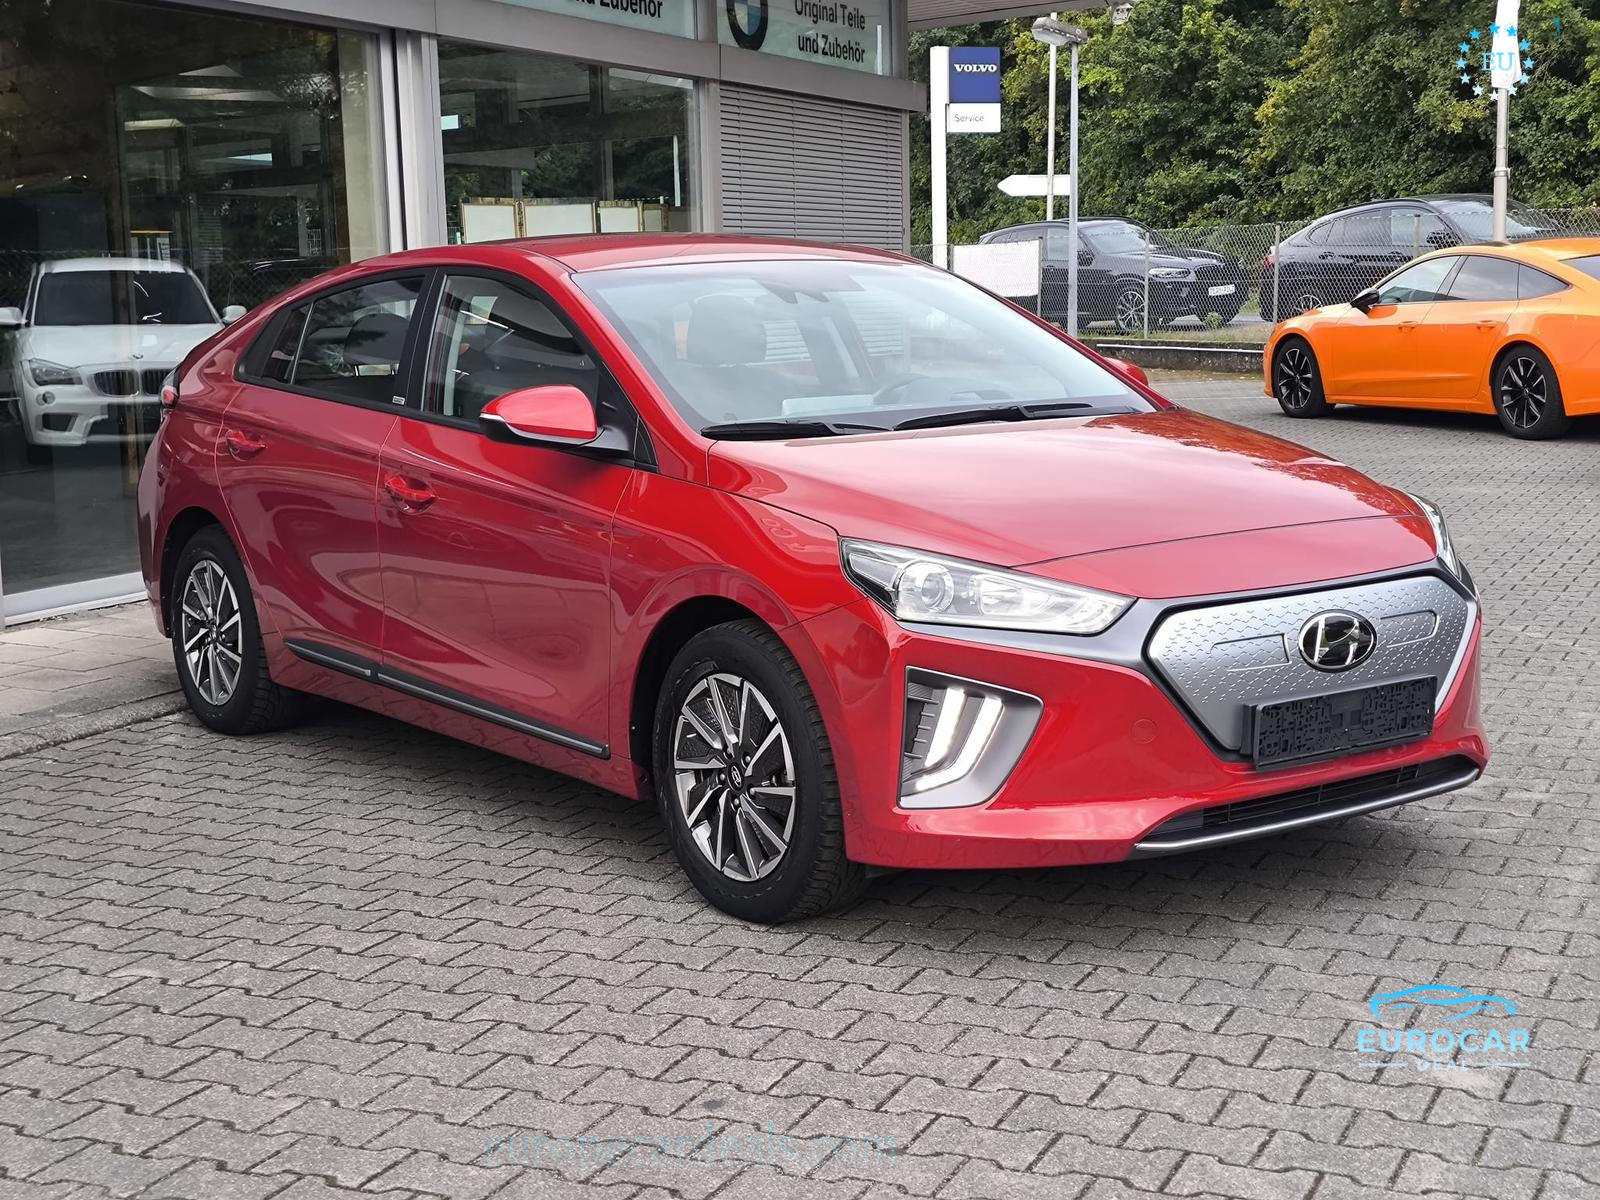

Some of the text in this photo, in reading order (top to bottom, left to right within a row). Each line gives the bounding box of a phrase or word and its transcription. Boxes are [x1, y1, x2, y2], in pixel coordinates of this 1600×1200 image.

[794, 0, 866, 30] Original Teile
[797, 33, 866, 63] und Zubehör
[954, 64, 997, 72] VOLVO
[954, 113, 985, 122] Service
